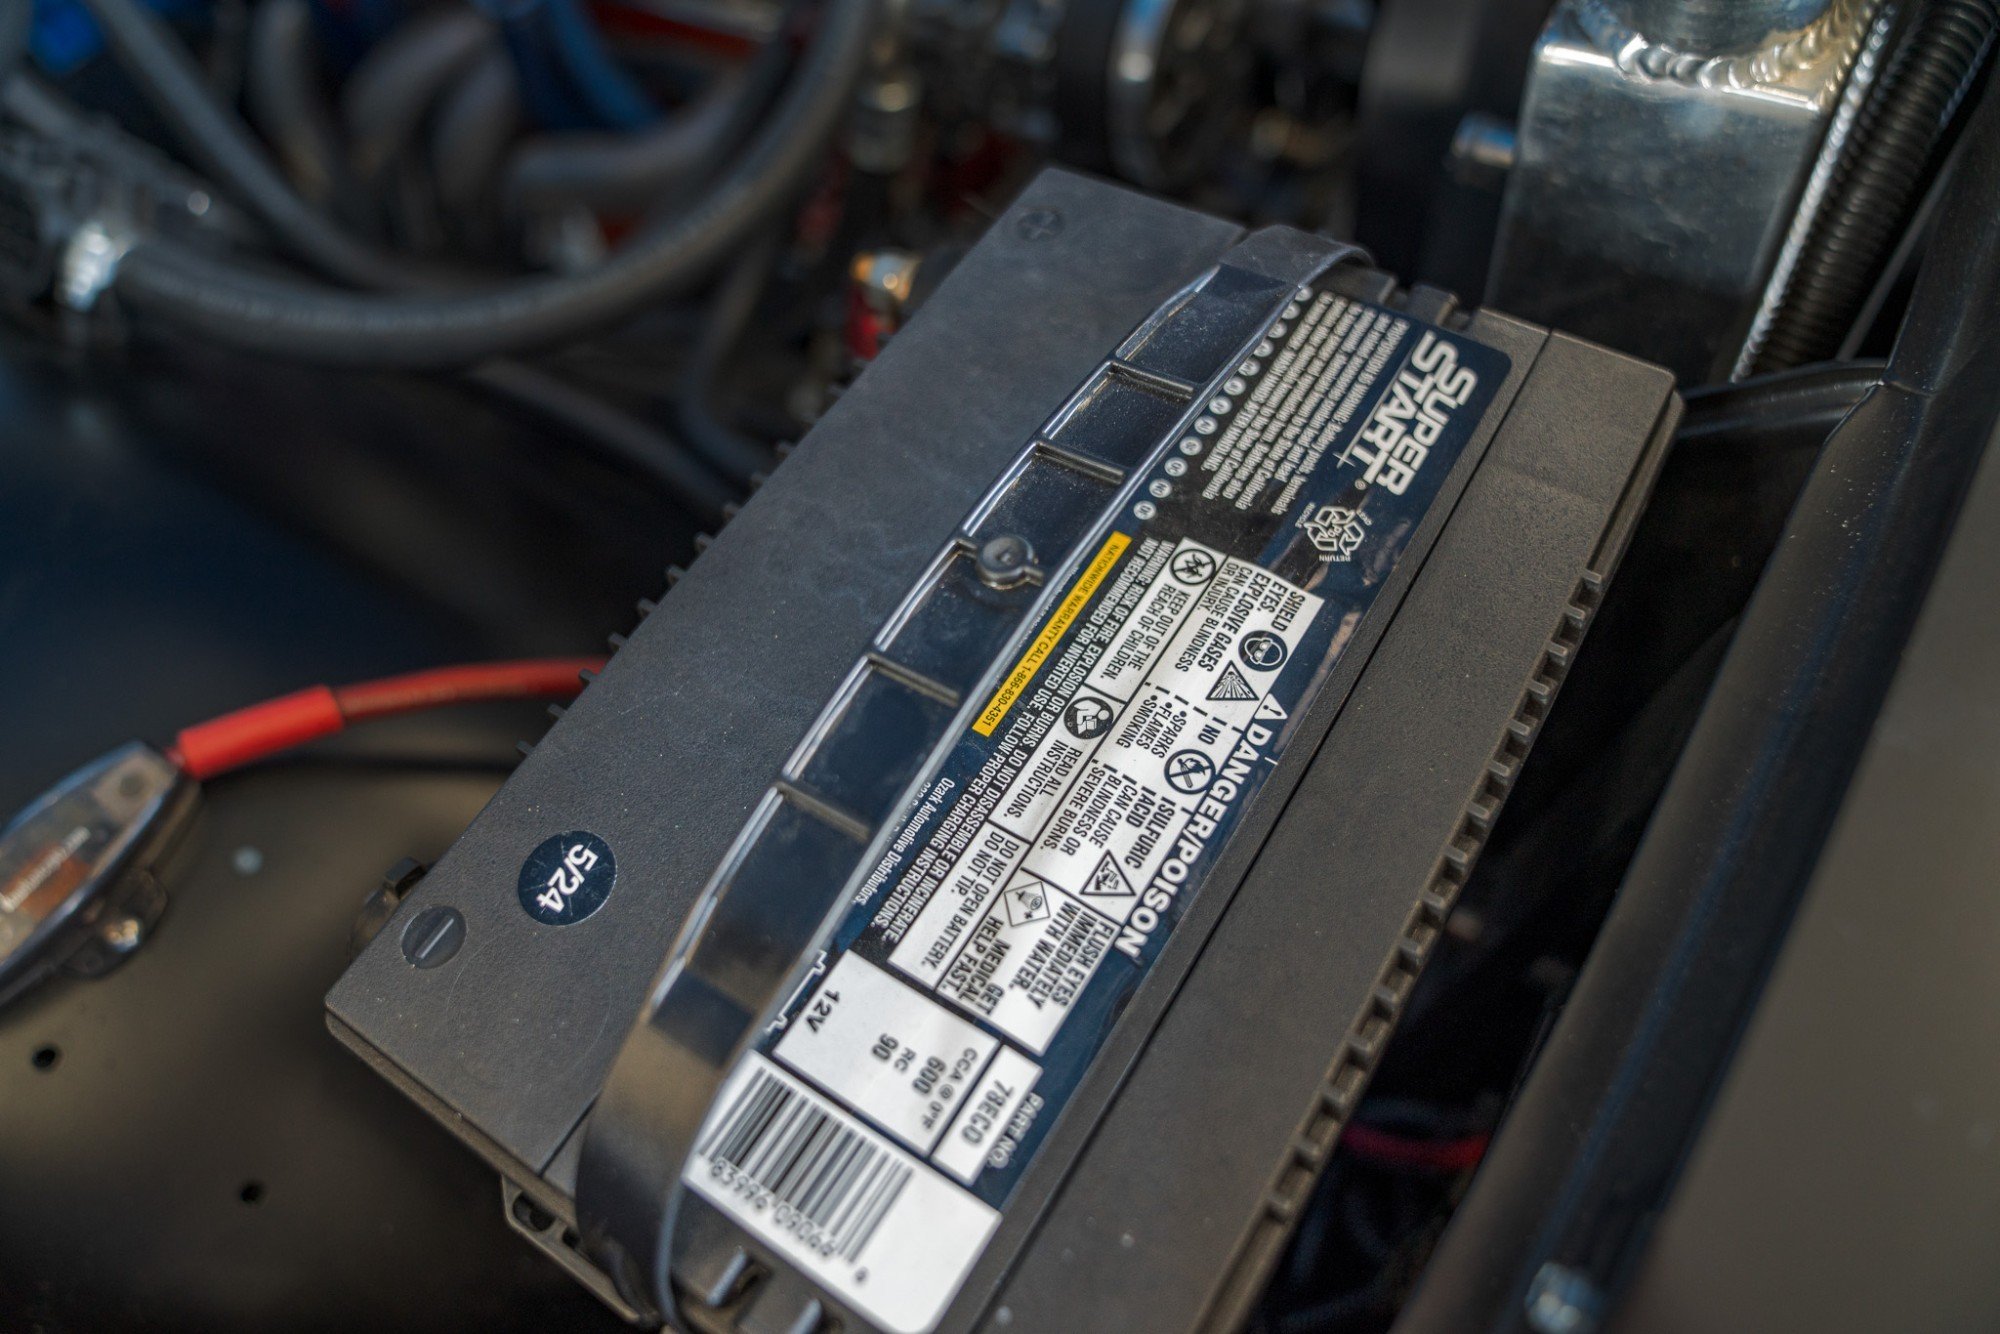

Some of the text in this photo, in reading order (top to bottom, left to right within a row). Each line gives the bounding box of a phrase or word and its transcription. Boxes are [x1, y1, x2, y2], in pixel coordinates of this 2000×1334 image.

[1267, 349, 1296, 376] WASH
[1305, 358, 1326, 377] and
[1314, 353, 1347, 393] chemicals
[1250, 373, 1279, 403] HANDS
[1266, 381, 1292, 408] known
[1275, 373, 1314, 422] reproductive
[1297, 390, 1324, 418] known
[1232, 400, 1260, 428] AFTER
[1249, 413, 1269, 430] the
[1258, 405, 1275, 417] to
[1291, 415, 1307, 427] to
[1308, 398, 1337, 429] contain
[1351, 332, 1456, 483] START
[1236, 427, 1260, 451] State
[1281, 423, 1302, 440] the
[1297, 426, 1319, 448] lead
[1311, 422, 1342, 453] Battery
[1375, 360, 1475, 495] SUPER
[1228, 447, 1245, 462] of
[1234, 442, 1269, 481] Batteries
[1260, 458, 1277, 472] of
[1268, 437, 1292, 461] State
[1286, 444, 1305, 464] and
[1294, 449, 1322, 476] posts,
[1151, 482, 1167, 496] NO
[1201, 458, 1239, 500] California
[1221, 478, 1244, 500] also
[1235, 468, 1272, 510] California
[1274, 460, 1296, 483] lead
[1270, 474, 1306, 515] terminals
[1295, 502, 1316, 528] RECYCLE
[1327, 523, 1343, 538] Pb
[1135, 540, 1175, 585] WARNING:
[1137, 537, 1159, 560] NOT
[1319, 554, 1351, 562] RETURN
[1079, 544, 1119, 593] NATIONWIDE
[1197, 562, 1239, 611] OR INJURY.
[1090, 556, 1145, 625] RECOMMENDED
[1119, 583, 1145, 609] RISK
[1256, 580, 1289, 613] EYES.
[1044, 594, 1083, 642] WARRANTY
[1111, 605, 1129, 622] OF
[1174, 566, 1253, 672] CAN CAUSE BLINDNESS
[1197, 572, 1271, 672] EXPLOSIVE GASES
[1270, 591, 1306, 632] SHIELD
[1075, 622, 1099, 645] FOR
[1092, 618, 1120, 644] FIRE,
[1100, 583, 1177, 680] REACH OF CHILDREN.
[1127, 590, 1191, 671] KEEP OUT OF THE
[1025, 641, 1049, 664] CALL
[1044, 642, 1084, 690] INVERTED
[1057, 643, 1102, 698] EXPLOSION
[1026, 688, 1052, 711] USE.
[1045, 695, 1065, 713] OR
[997, 711, 1035, 755] FOLLOW
[1019, 711, 1055, 747] BURNS.
[1197, 724, 1221, 745] NO
[968, 752, 1006, 795] PROPER
[1008, 748, 1028, 767] DO
[1038, 746, 1083, 797] READ ALL
[928, 777, 955, 804] Ozark
[992, 764, 1017, 791] NOT
[1003, 739, 1069, 818] INSTRUCTIONS.
[892, 801, 937, 852] Automotive
[929, 793, 976, 849] CHARGING
[941, 787, 1001, 861] DISASSEMBLE
[1039, 766, 1106, 850] SEVERE BURNS.
[1059, 774, 1122, 856] BLINDNESS OR
[1088, 784, 1138, 848] CAN CAUSE
[1125, 793, 1156, 828] ACID
[1116, 723, 1272, 955] DANGER/POISON
[1124, 803, 1175, 869] SULFURIC
[536, 844, 599, 913] 5/24
[929, 858, 950, 878] OR
[950, 830, 1005, 896] DO NOT TIP.
[871, 847, 938, 927] INSTRUCTIONS.
[921, 839, 1020, 969] DO NOT OPEN BATTERY.
[881, 875, 938, 942] INCINERATE.
[942, 915, 1004, 992] HELP FAST.
[1008, 901, 1081, 993] WITH WATER.
[1028, 911, 1097, 1008] IMMEDIATELY
[1051, 921, 1115, 1007] FLUSH EYES
[958, 939, 1010, 1002] MEDICAL
[803, 988, 840, 1033] 12V
[975, 983, 1004, 1015] GET
[871, 1033, 899, 1061] 90
[894, 1048, 916, 1071] RC
[948, 1047, 978, 1082] CCA
[911, 1055, 946, 1095] 600
[1007, 1091, 1044, 1139] PART
